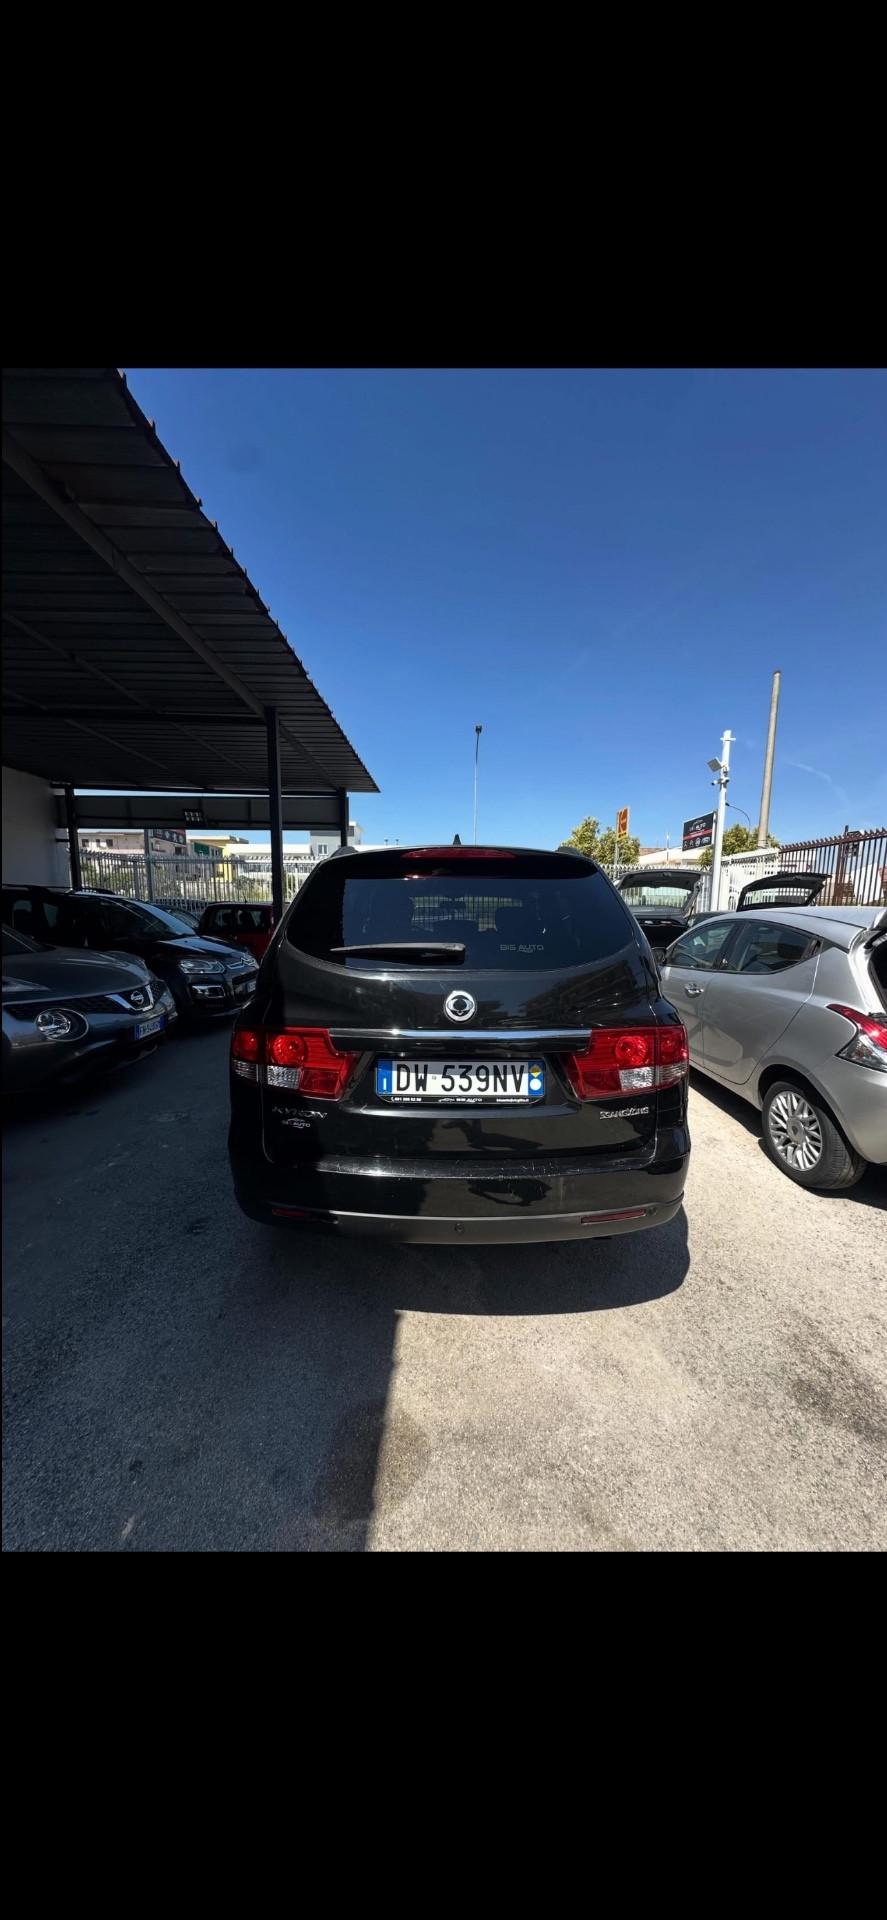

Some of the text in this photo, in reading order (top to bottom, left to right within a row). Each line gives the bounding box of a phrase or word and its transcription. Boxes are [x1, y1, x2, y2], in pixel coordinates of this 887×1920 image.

[519, 944, 544, 953] AUTO
[396, 1064, 429, 1092] DW
[441, 1064, 525, 1093] 539NV
